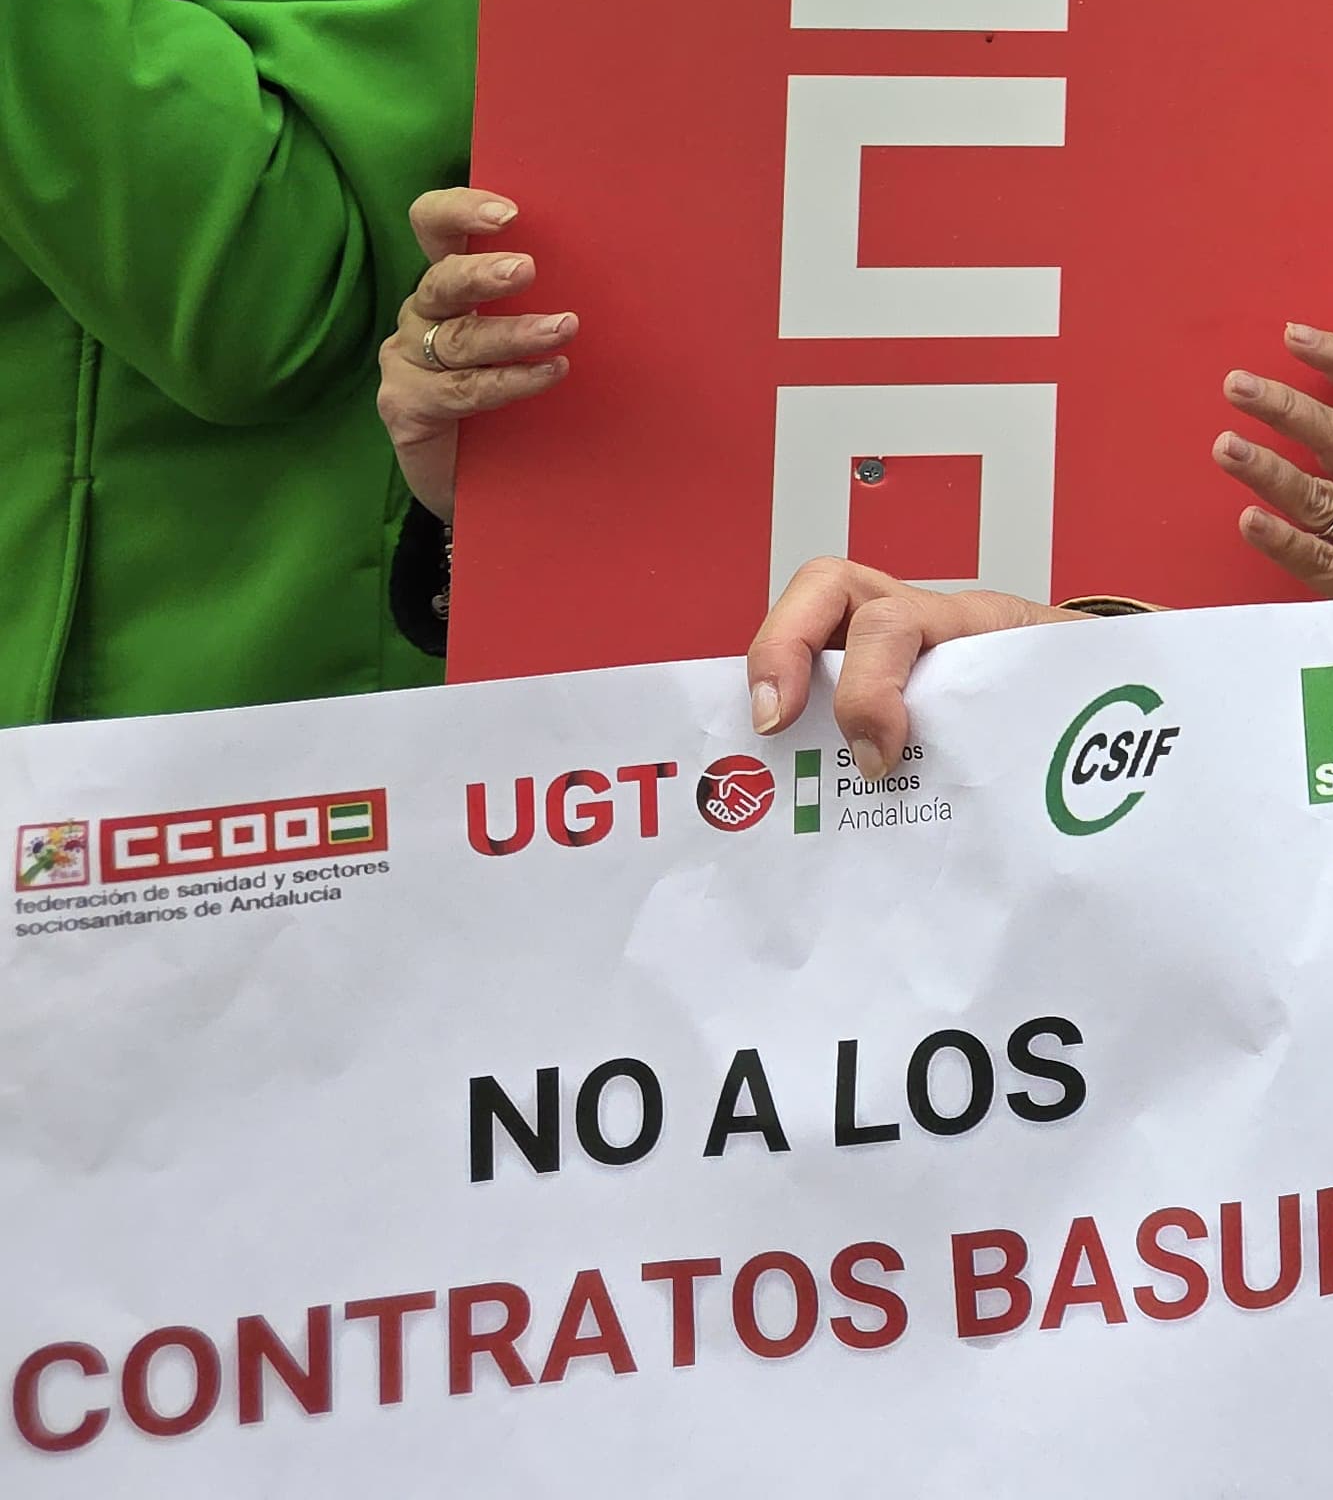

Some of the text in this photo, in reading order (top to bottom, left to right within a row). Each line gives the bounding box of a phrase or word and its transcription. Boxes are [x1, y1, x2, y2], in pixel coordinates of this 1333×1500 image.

[1070, 726, 1180, 786] CSIF
[113, 806, 320, 871] CCOO
[465, 761, 678, 857] UGT
[838, 797, 952, 831] Andalucía
[15, 859, 390, 915] federación de sanidad y sectores
[15, 883, 342, 938] sociosanitarios de Andalucía
[468, 1016, 1087, 1183] NO A LOS
[12, 1240, 909, 1452] CONTRATOS
